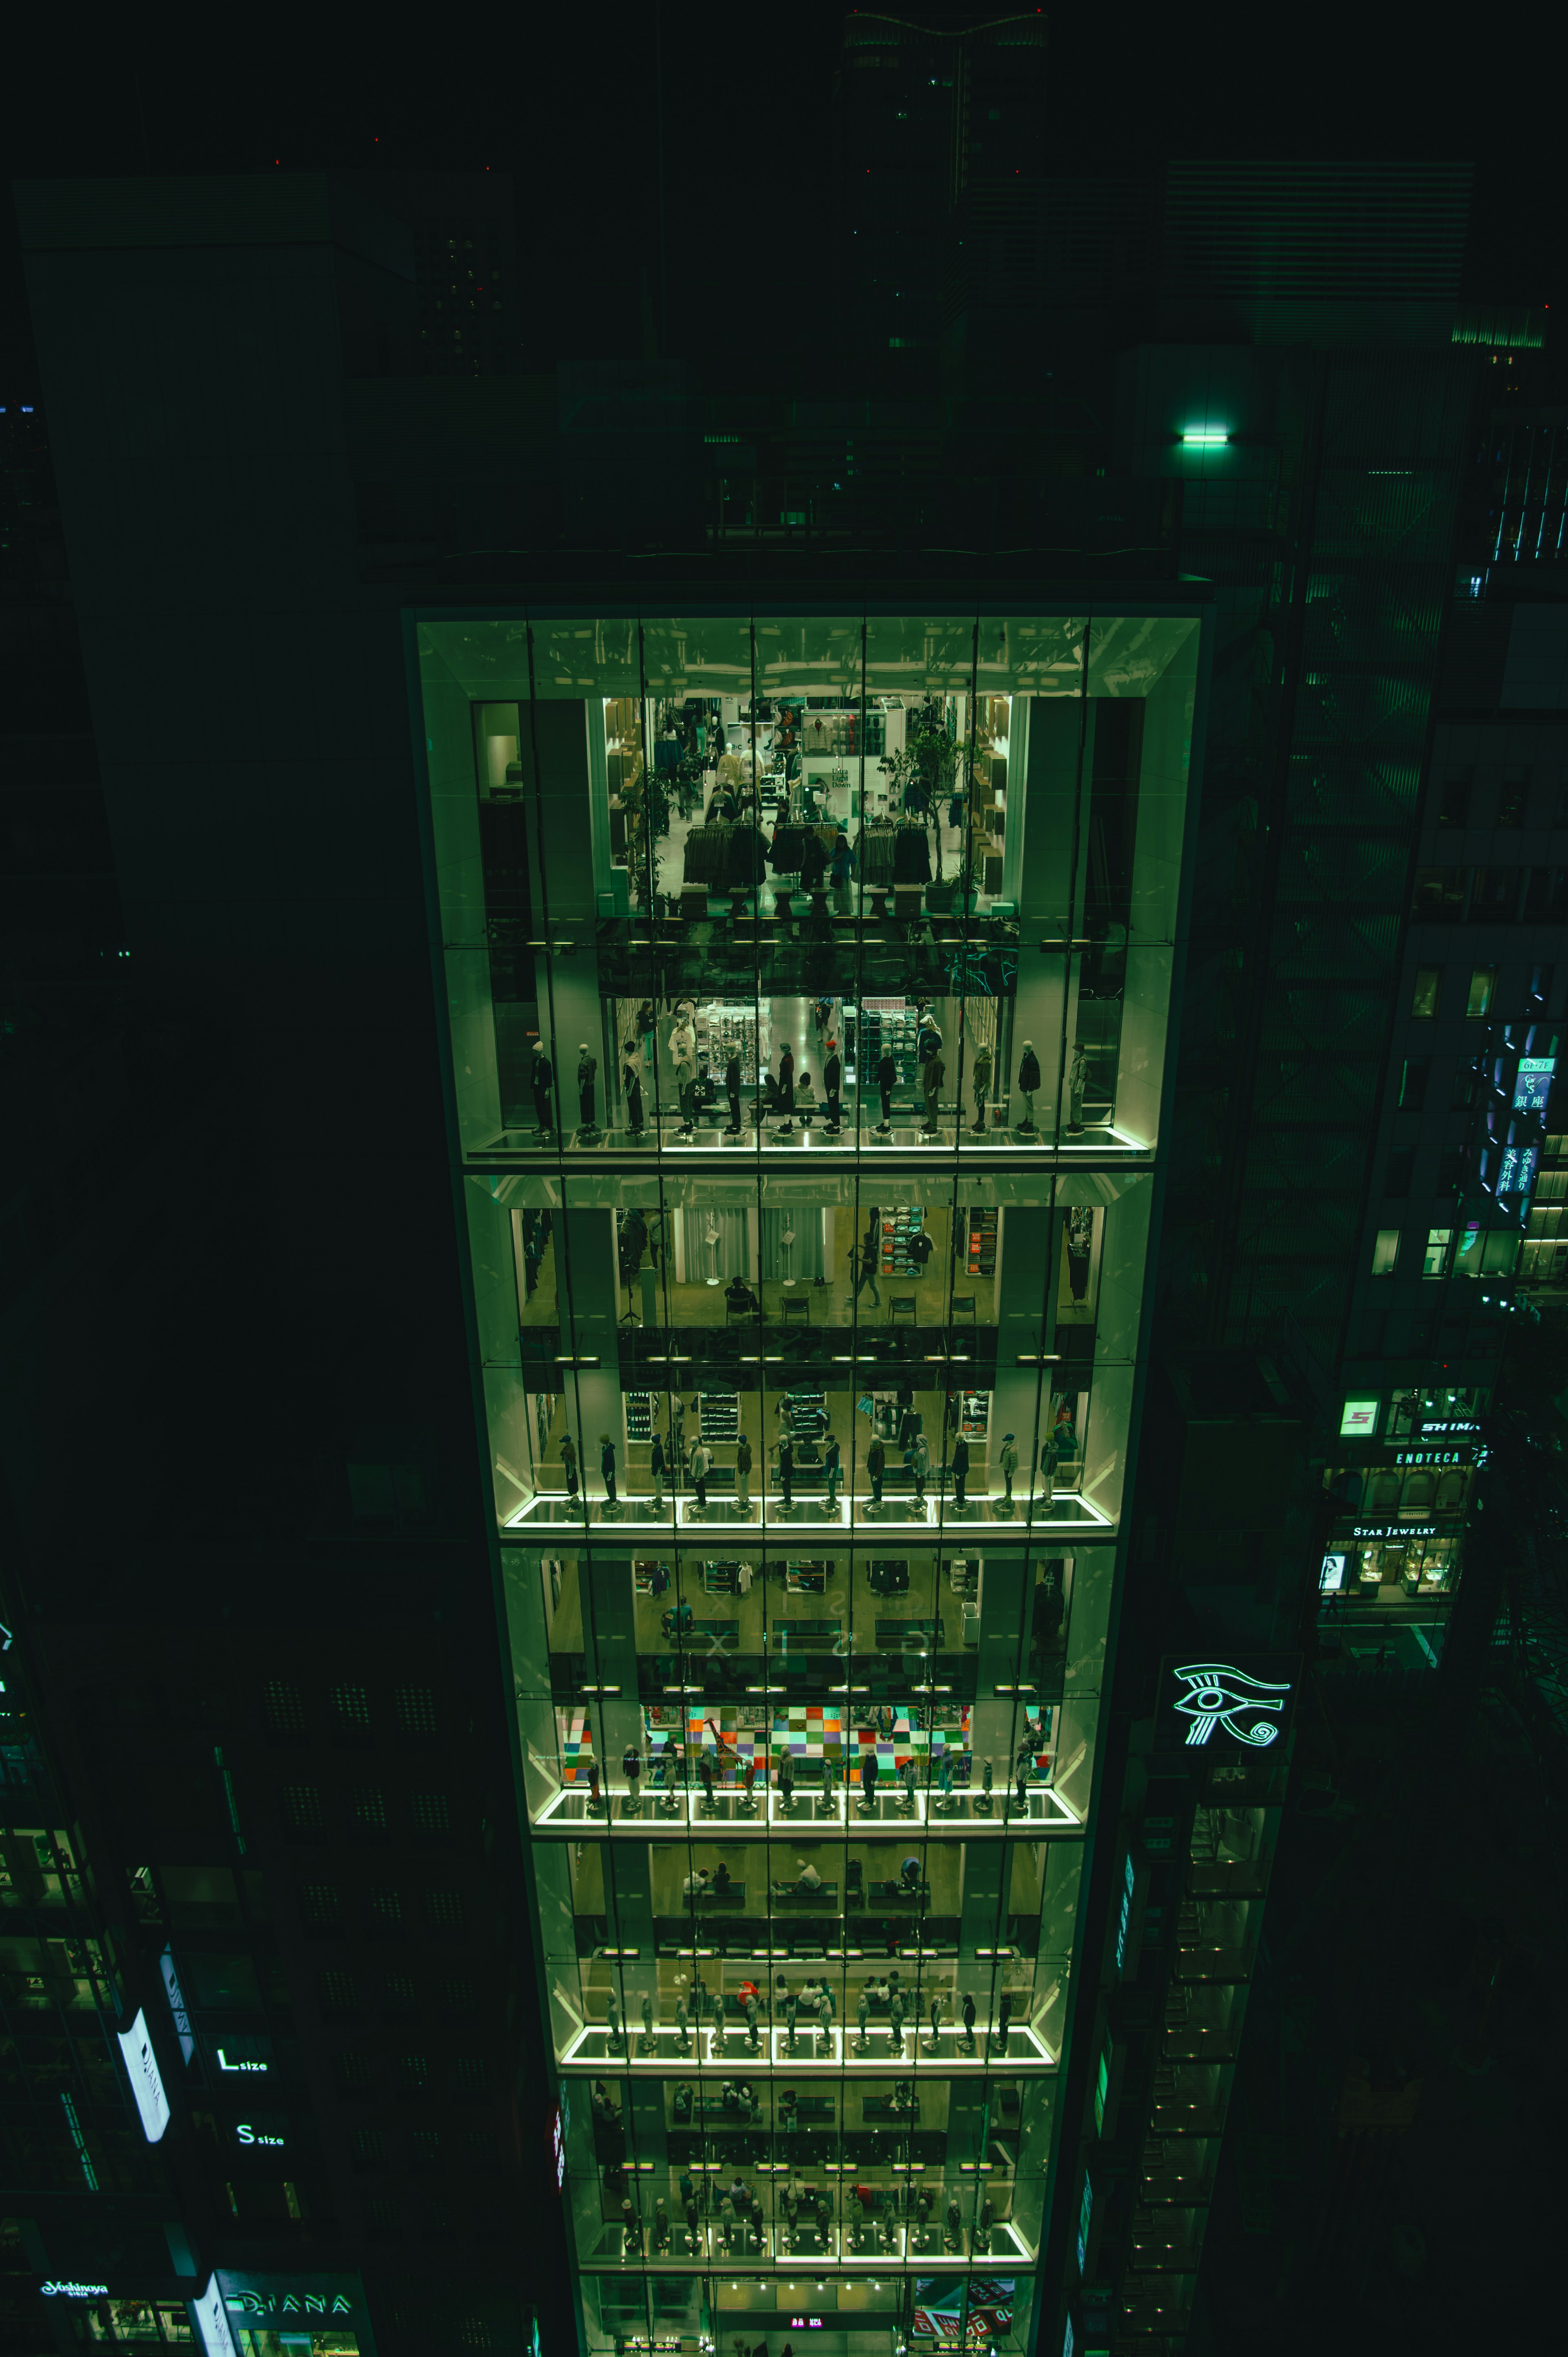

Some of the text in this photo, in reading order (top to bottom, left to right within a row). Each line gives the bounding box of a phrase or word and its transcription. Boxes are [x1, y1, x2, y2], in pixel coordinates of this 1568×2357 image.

[1514, 1095, 1545, 1108] 銀座
[1499, 1149, 1517, 1191] 美容外科
[1518, 1149, 1532, 1191] みゆき通り
[1396, 1452, 1460, 1465] ENOTECA
[217, 2048, 268, 2072] L size
[142, 2042, 160, 2106] DIANA
[237, 2124, 285, 2146] S size
[42, 2281, 109, 2295] Yoshinoya
[225, 2292, 350, 2316] DIANA
